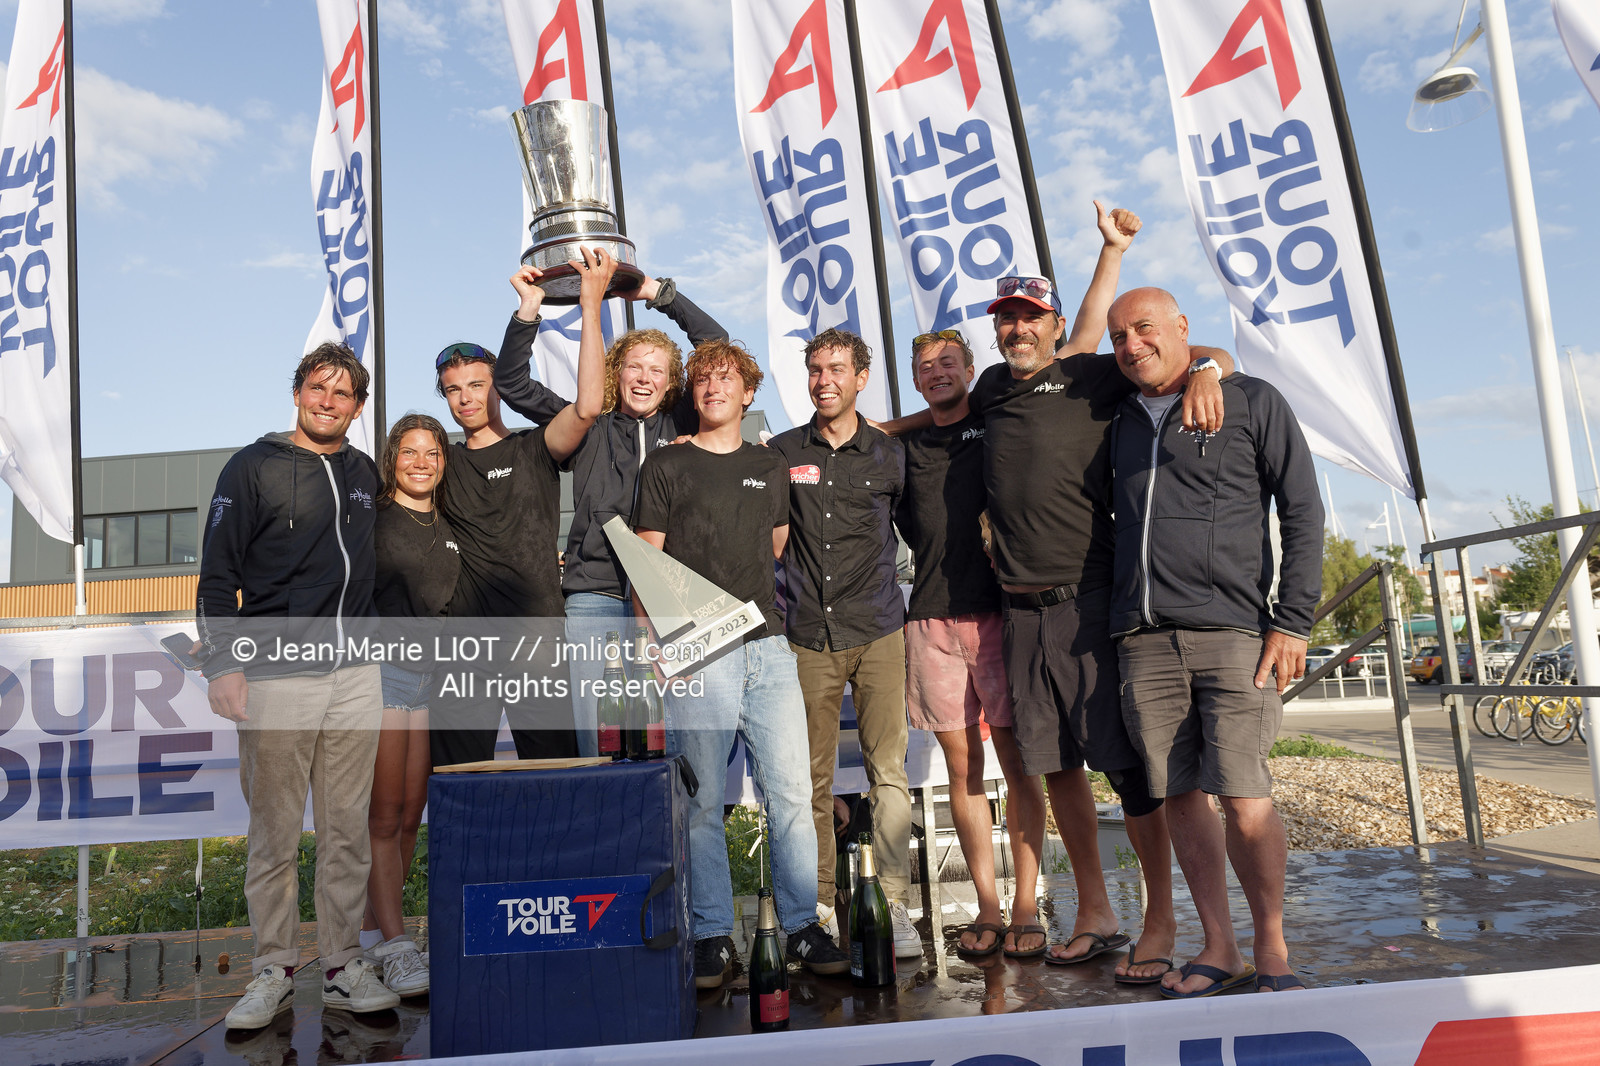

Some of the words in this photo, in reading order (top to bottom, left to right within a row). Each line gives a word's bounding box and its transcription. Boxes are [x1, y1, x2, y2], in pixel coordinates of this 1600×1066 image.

[790, 472, 819, 481] oricher
[718, 614, 748, 637] 2023
[497, 895, 571, 918] TOUR
[507, 914, 577, 937] VOILE
